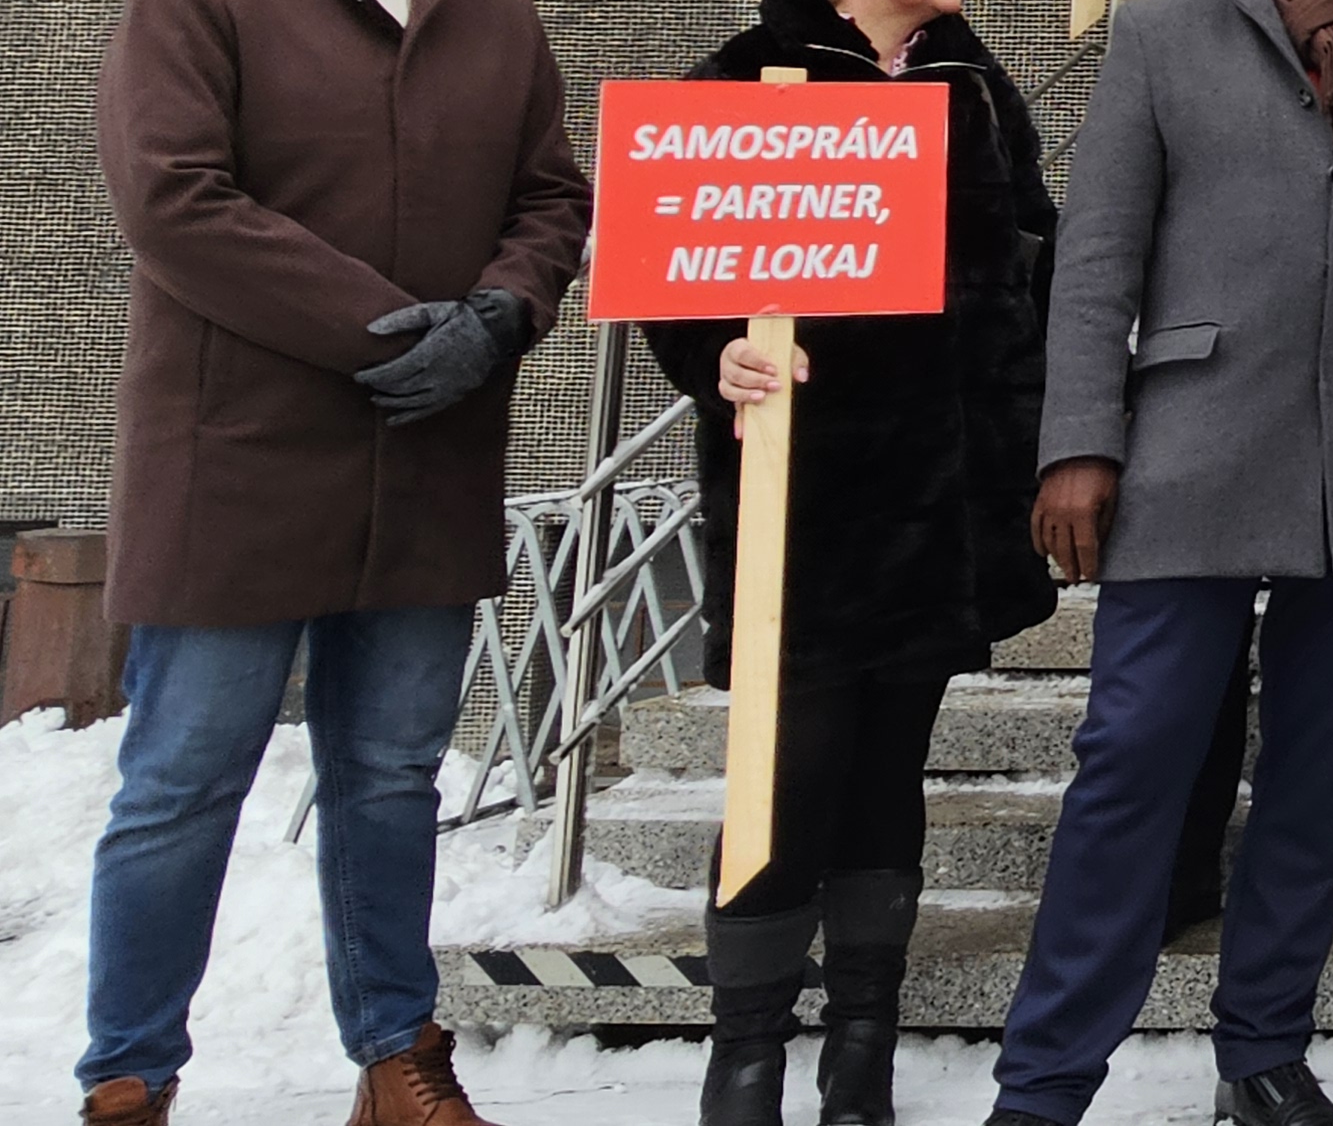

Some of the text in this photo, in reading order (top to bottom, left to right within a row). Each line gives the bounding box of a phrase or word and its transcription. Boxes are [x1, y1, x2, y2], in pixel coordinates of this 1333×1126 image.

[628, 116, 918, 161] SAMOSPRÁVA
[654, 184, 891, 225] = PARTNER,
[666, 243, 879, 282] NIE LOKAJ
